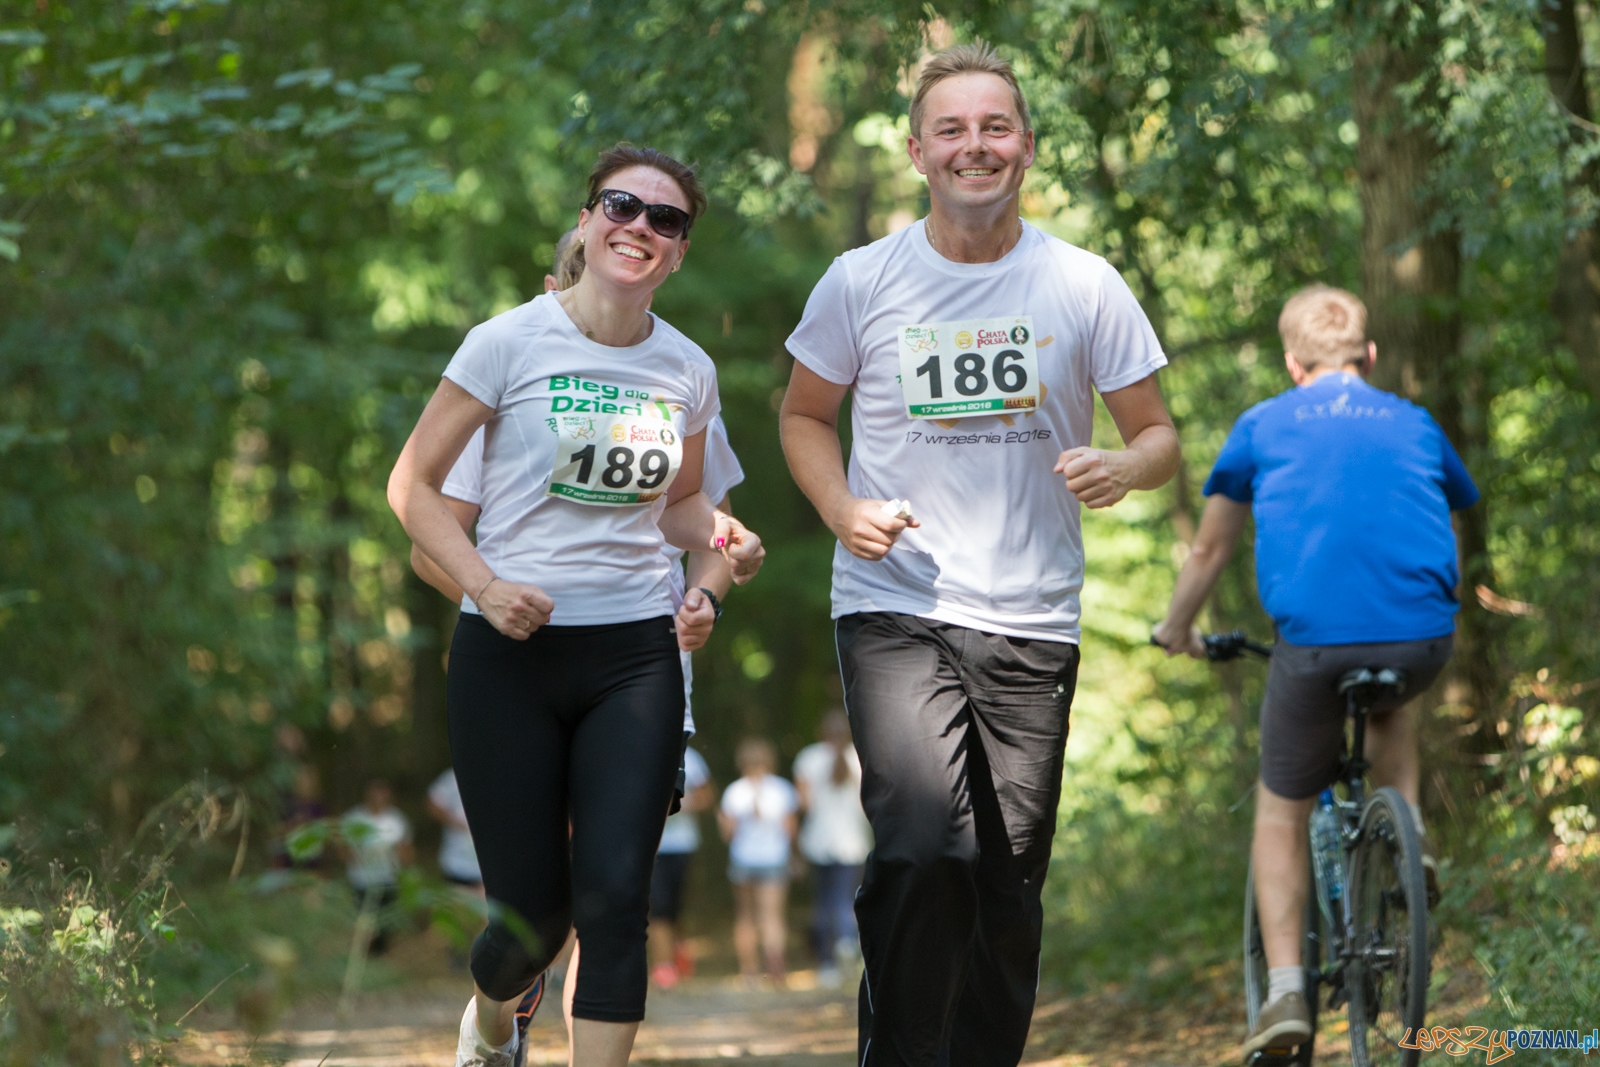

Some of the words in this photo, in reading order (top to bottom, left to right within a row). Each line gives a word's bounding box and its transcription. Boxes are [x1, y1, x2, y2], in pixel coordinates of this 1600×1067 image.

[976, 338, 1010, 348] POLSKA
[916, 349, 1028, 399] 186
[548, 375, 619, 400] Bieg
[625, 389, 650, 401] dla
[551, 396, 642, 416] Dzieci
[932, 404, 967, 413] września
[967, 402, 992, 410] 2016
[631, 425, 656, 435] CHATA
[906, 431, 922, 442] 17
[925, 432, 1002, 444] września
[1005, 429, 1052, 444] 2016
[630, 434, 659, 444] POLSKA
[570, 444, 670, 490] 189
[574, 491, 605, 500] września
[606, 494, 629, 502] 2016
